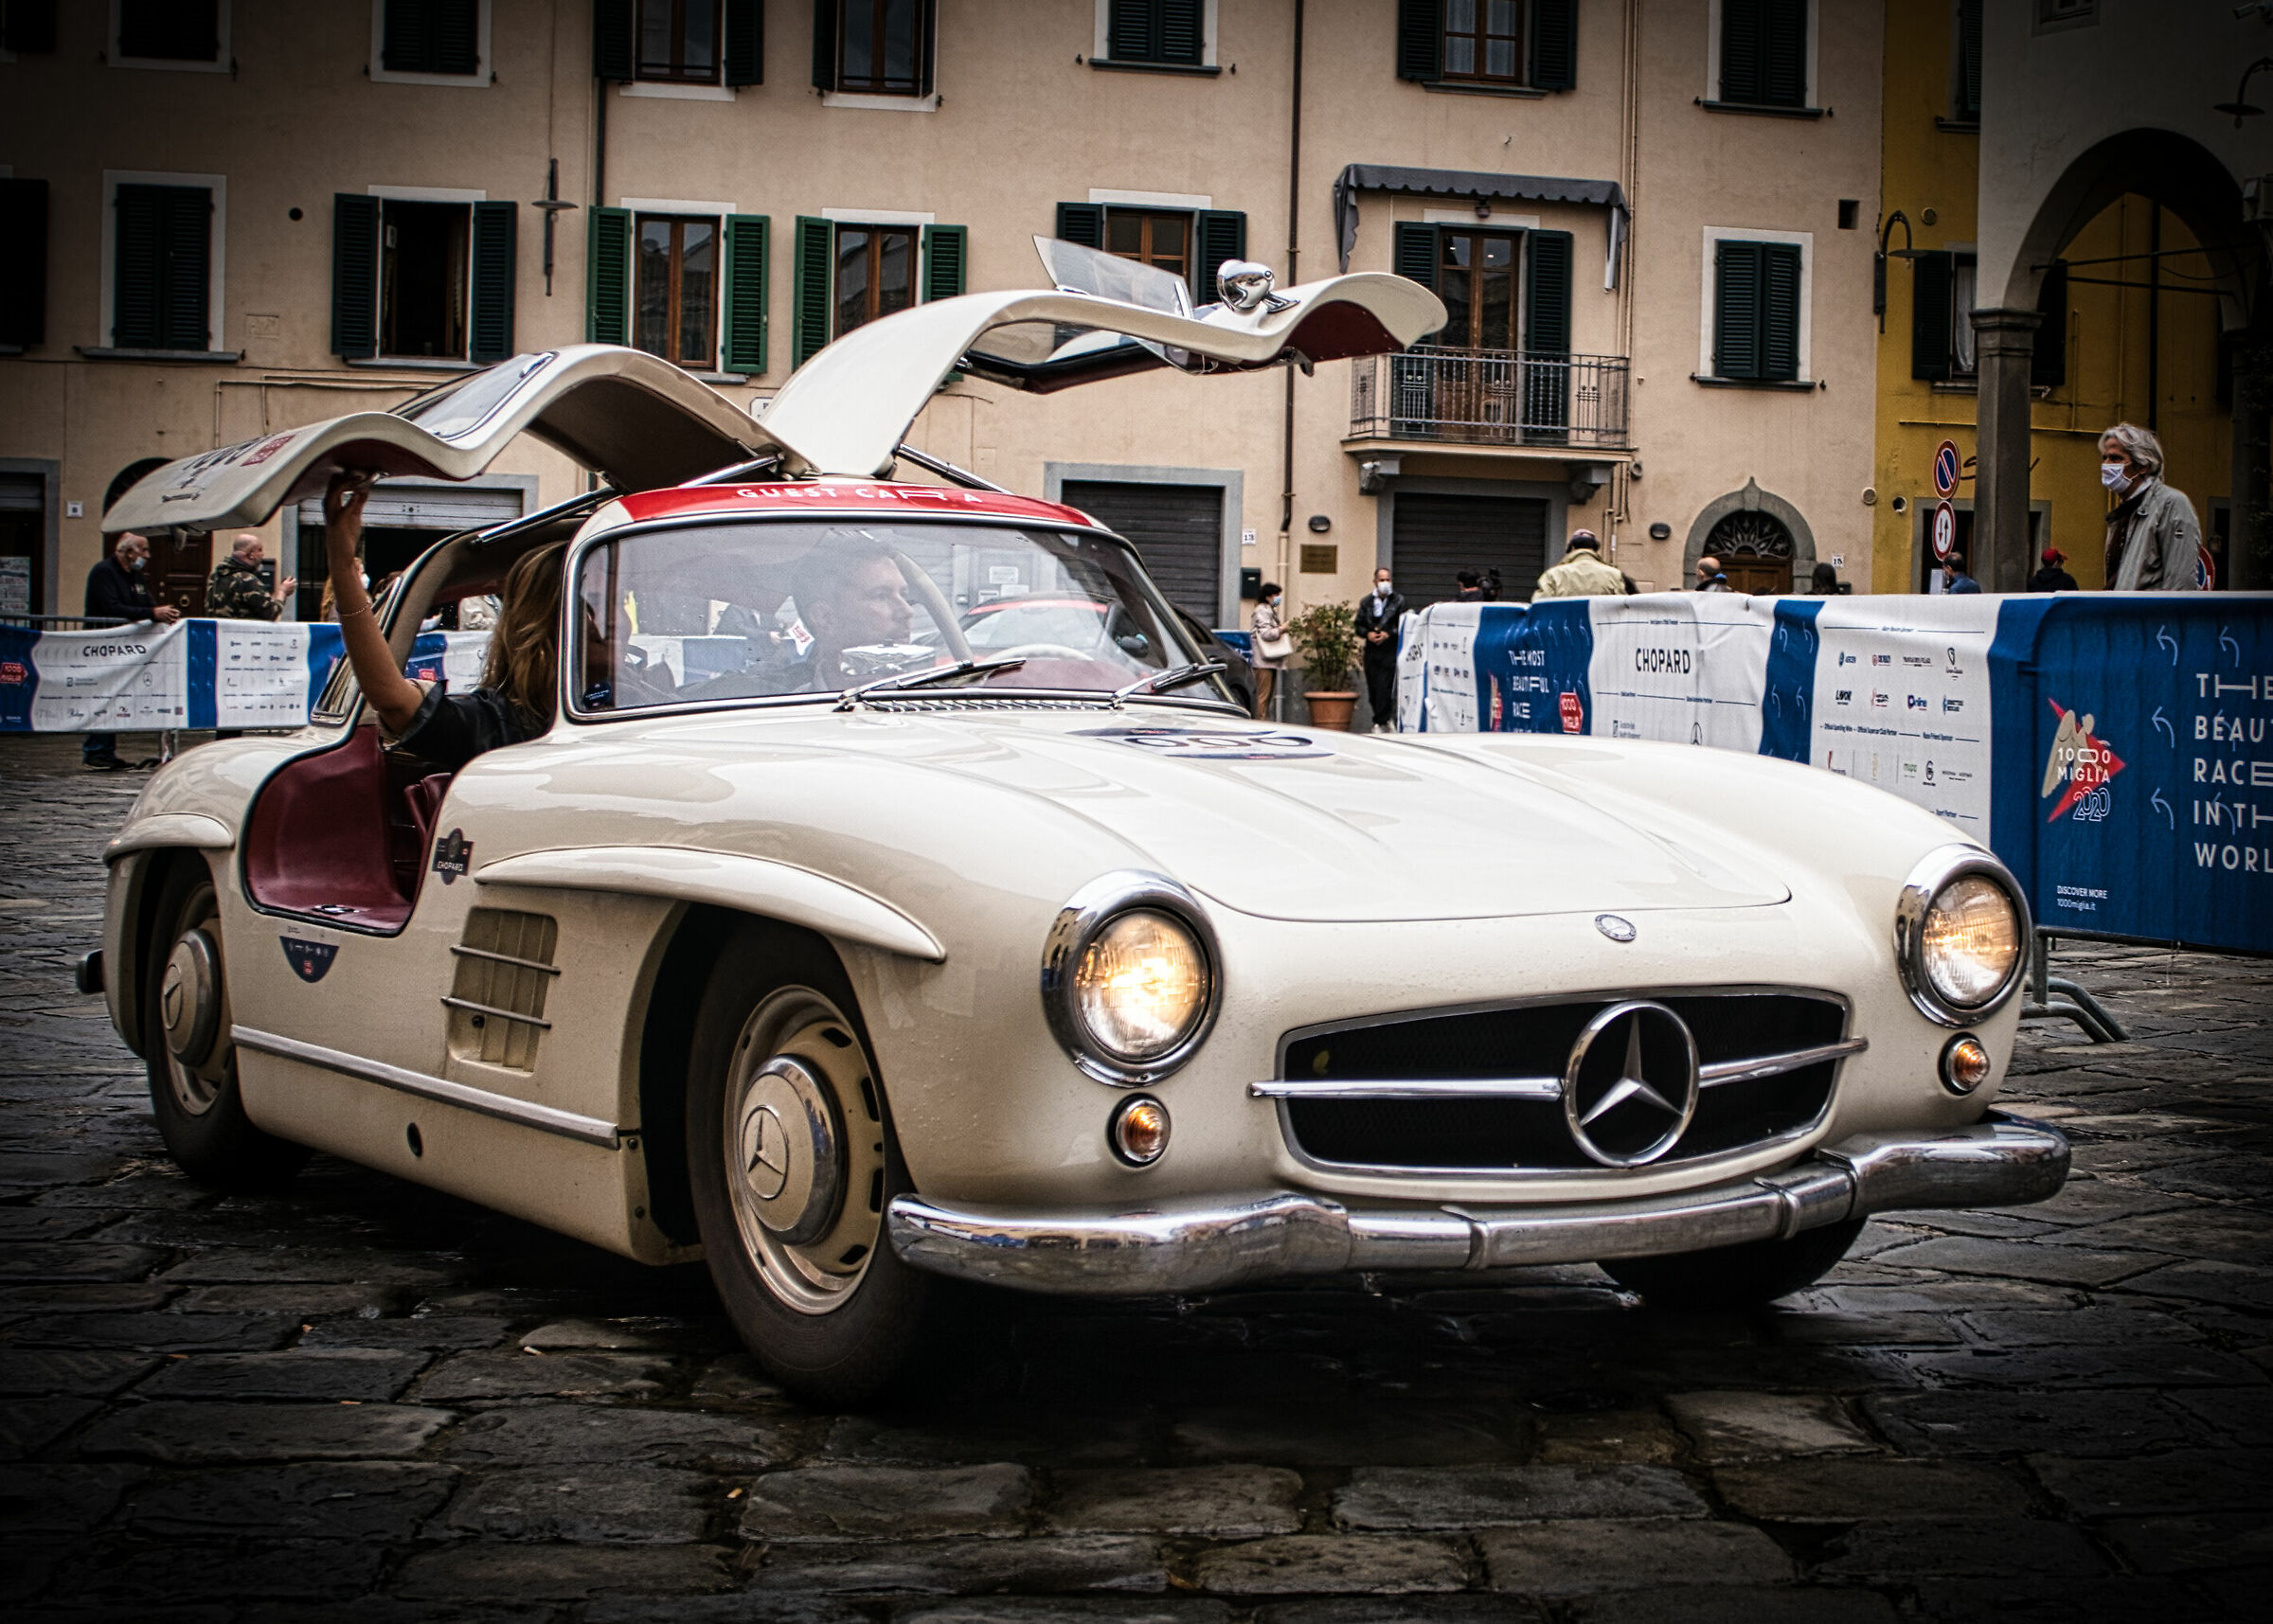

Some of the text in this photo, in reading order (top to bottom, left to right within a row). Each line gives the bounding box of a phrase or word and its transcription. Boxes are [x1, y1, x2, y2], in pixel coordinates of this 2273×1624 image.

[736, 487, 837, 499] GUEST
[82, 644, 147, 658] CHOPARD
[1635, 648, 1691, 674] CHOPARD
[2195, 672, 2273, 701] THE
[2194, 714, 2273, 743] BEAU
[2057, 747, 2111, 764] 1000
[2057, 765, 2111, 784] MIGLIA
[2072, 786, 2111, 822] 2020
[2193, 799, 2221, 826] IN
[2056, 884, 2108, 900] DISCOVER MORE
